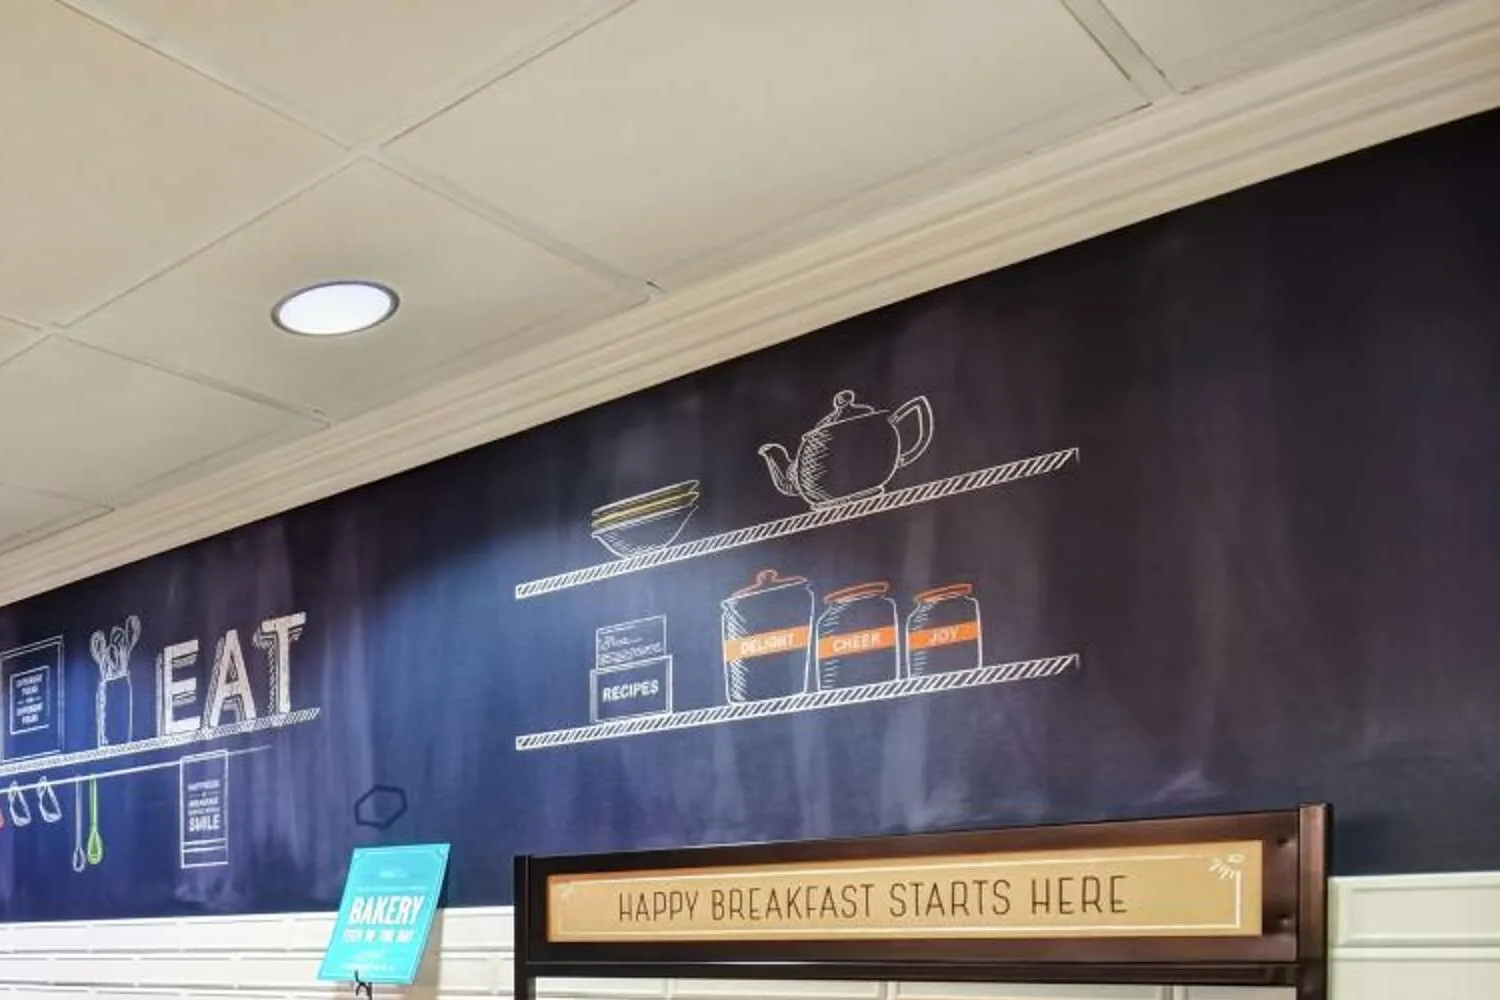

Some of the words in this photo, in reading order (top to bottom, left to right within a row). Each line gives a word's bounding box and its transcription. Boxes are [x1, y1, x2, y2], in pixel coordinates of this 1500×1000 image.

[740, 634, 796, 654] DELIGHT
[832, 633, 882, 652] CHEER
[929, 628, 959, 645] JOY
[156, 611, 307, 737] EAT
[603, 680, 659, 702] RECIPES
[618, 889, 699, 922] HAPPY
[711, 883, 875, 921] BREAKFAST
[889, 880, 1011, 917] STARTS
[1031, 874, 1128, 914] HERE
[349, 895, 425, 925] BAKERY
